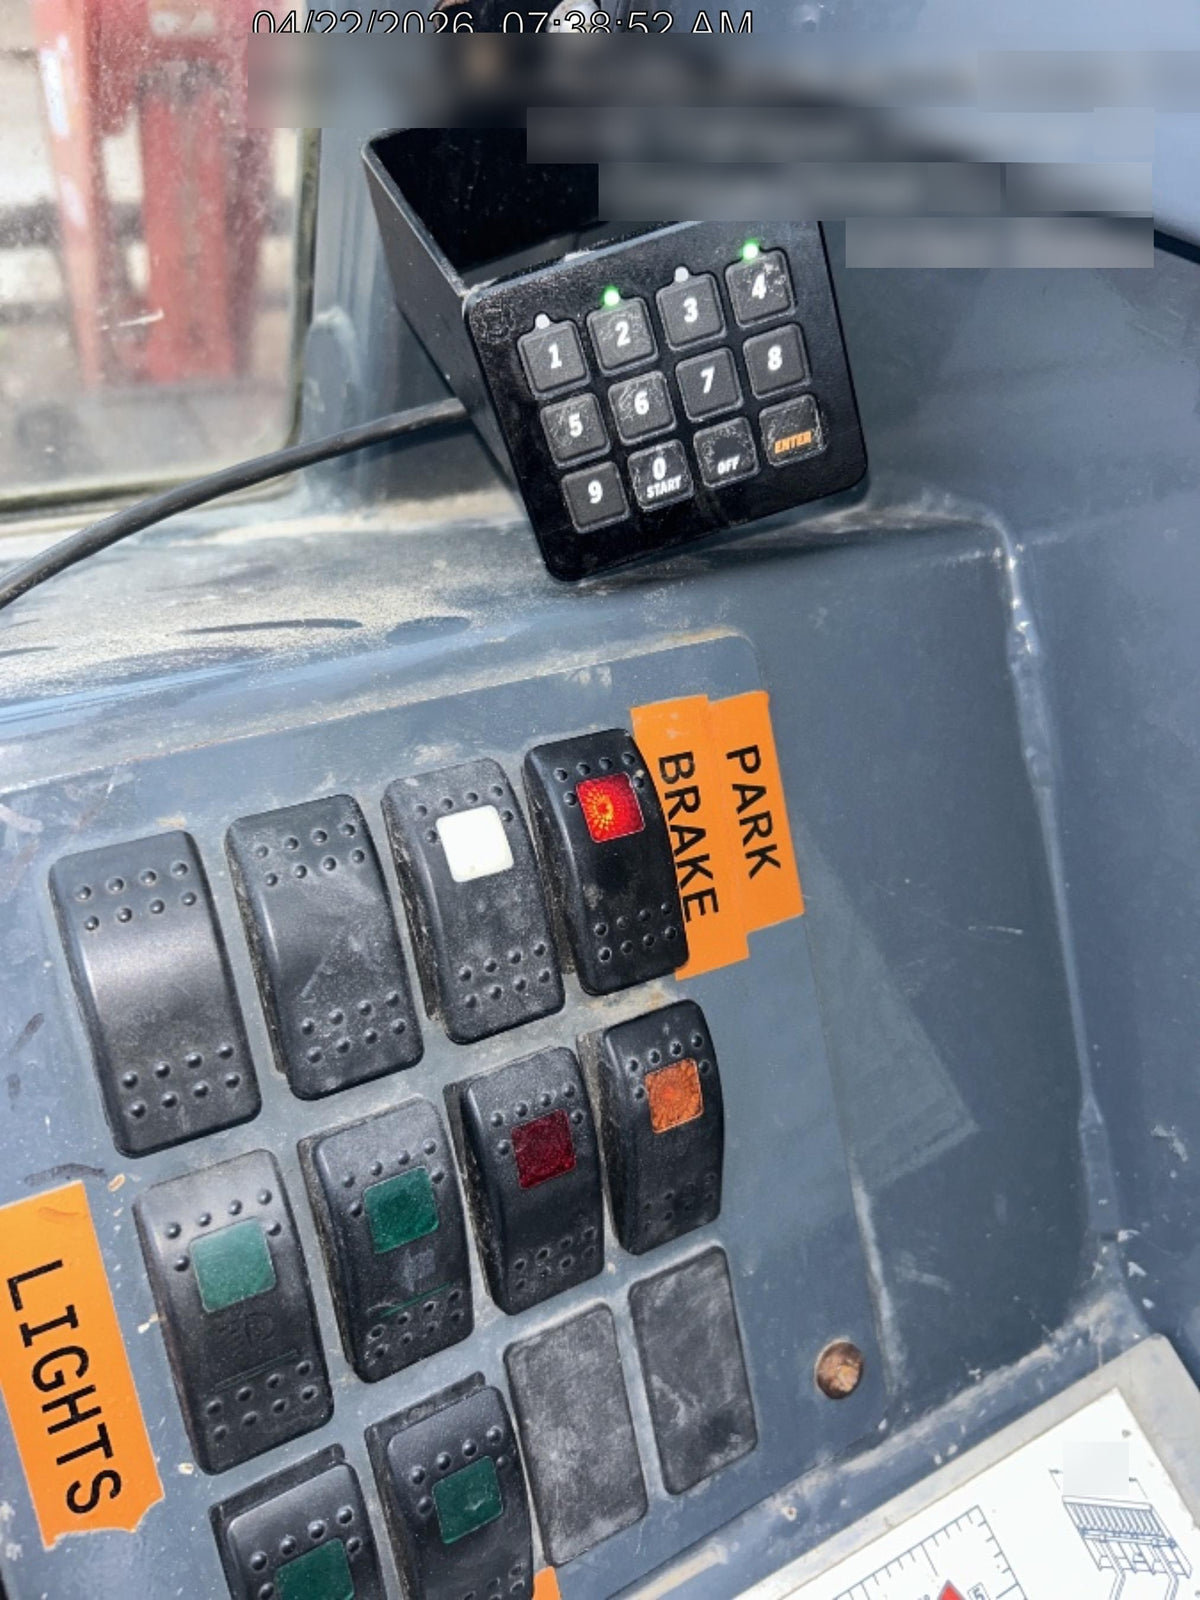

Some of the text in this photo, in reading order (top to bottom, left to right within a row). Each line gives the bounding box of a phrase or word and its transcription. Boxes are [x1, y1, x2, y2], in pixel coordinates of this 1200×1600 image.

[751, 271, 768, 300] 4
[683, 296, 699, 324] 3
[614, 320, 631, 347] 2
[547, 343, 563, 370] 1
[767, 344, 783, 372] 8
[700, 366, 716, 395] 7
[633, 389, 649, 415] 6
[567, 413, 584, 438] 5
[774, 430, 813, 455] ENTER
[651, 456, 667, 480] 0
[717, 455, 741, 476] OFF
[587, 479, 604, 505] 9
[646, 474, 682, 498] START
[726, 744, 781, 879] PARK
[658, 751, 719, 923] BRAKE
[7, 1259, 122, 1514] LIGHTS
